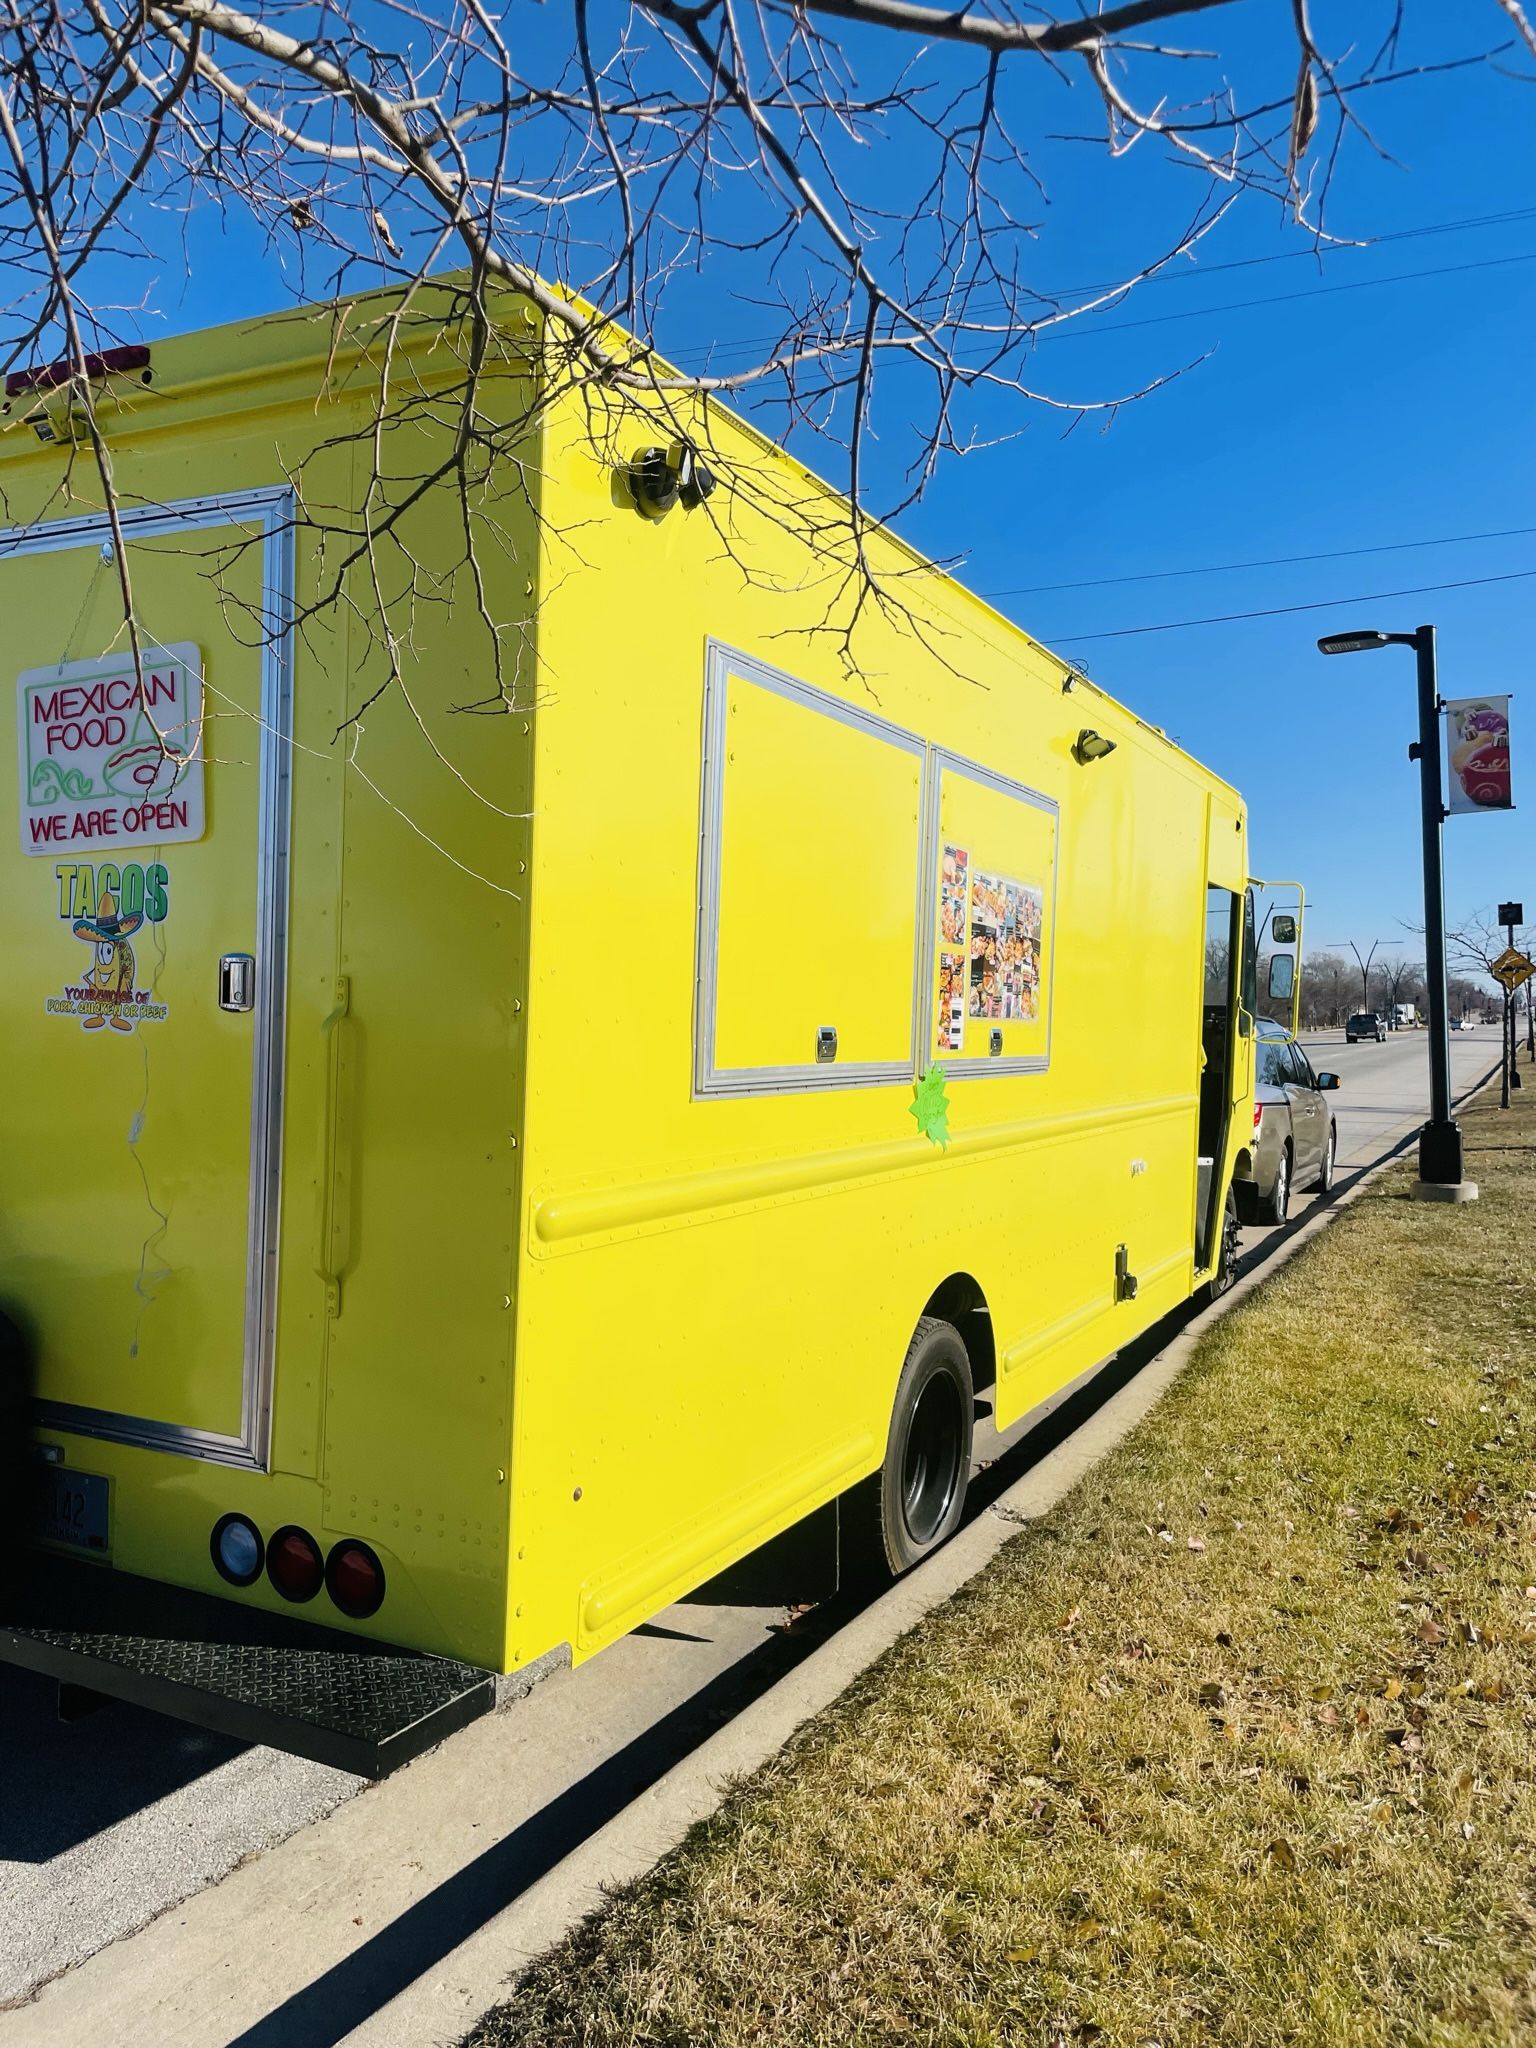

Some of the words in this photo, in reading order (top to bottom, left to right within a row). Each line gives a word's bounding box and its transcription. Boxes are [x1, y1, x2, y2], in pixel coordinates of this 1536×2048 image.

[34, 671, 176, 723] MEXICAN
[46, 717, 125, 754] FOOD
[30, 815, 67, 842] WE
[71, 809, 117, 838] ARE
[123, 801, 187, 831] OPEN
[56, 864, 168, 922] TACOS
[47, 999, 76, 1014] PORK,
[77, 1001, 121, 1016] CHICKEN
[123, 1005, 138, 1018] OR
[140, 1005, 167, 1020] BEEF
[65, 987, 97, 1001] YOUR
[135, 991, 150, 1005] OF
